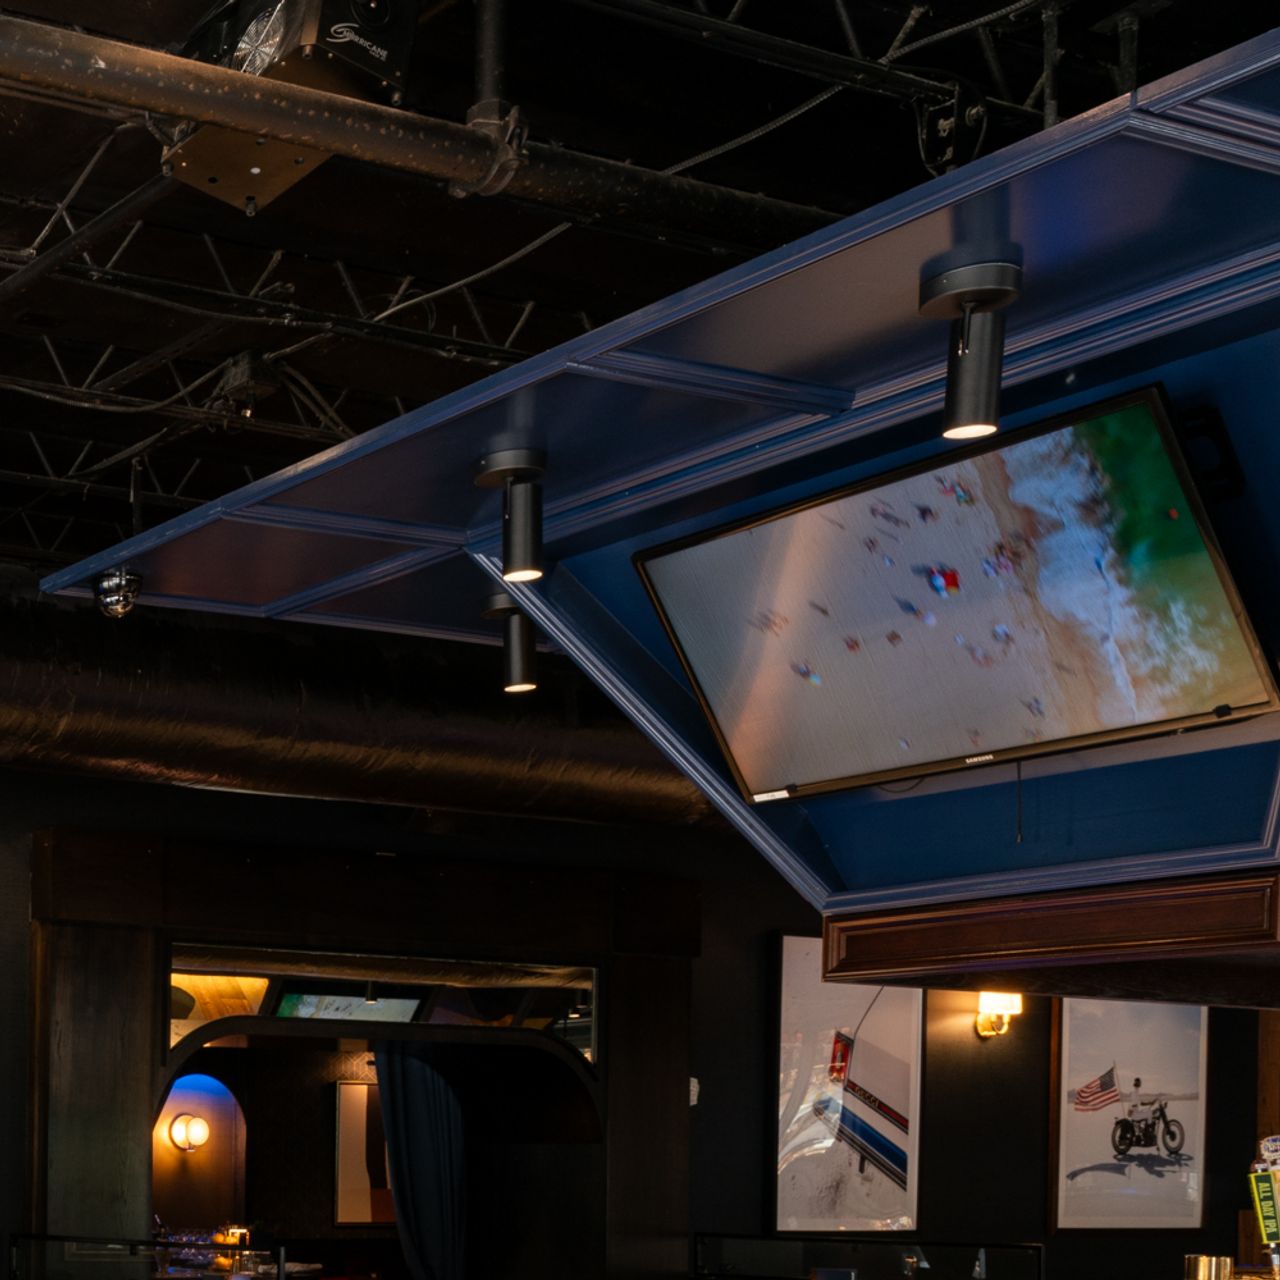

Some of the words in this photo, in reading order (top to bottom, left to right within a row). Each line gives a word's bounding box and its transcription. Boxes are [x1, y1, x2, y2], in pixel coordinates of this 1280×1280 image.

[1258, 1182, 1271, 1199] ALL
[1261, 1201, 1275, 1217] DAY
[1265, 1219, 1277, 1233] IPA
